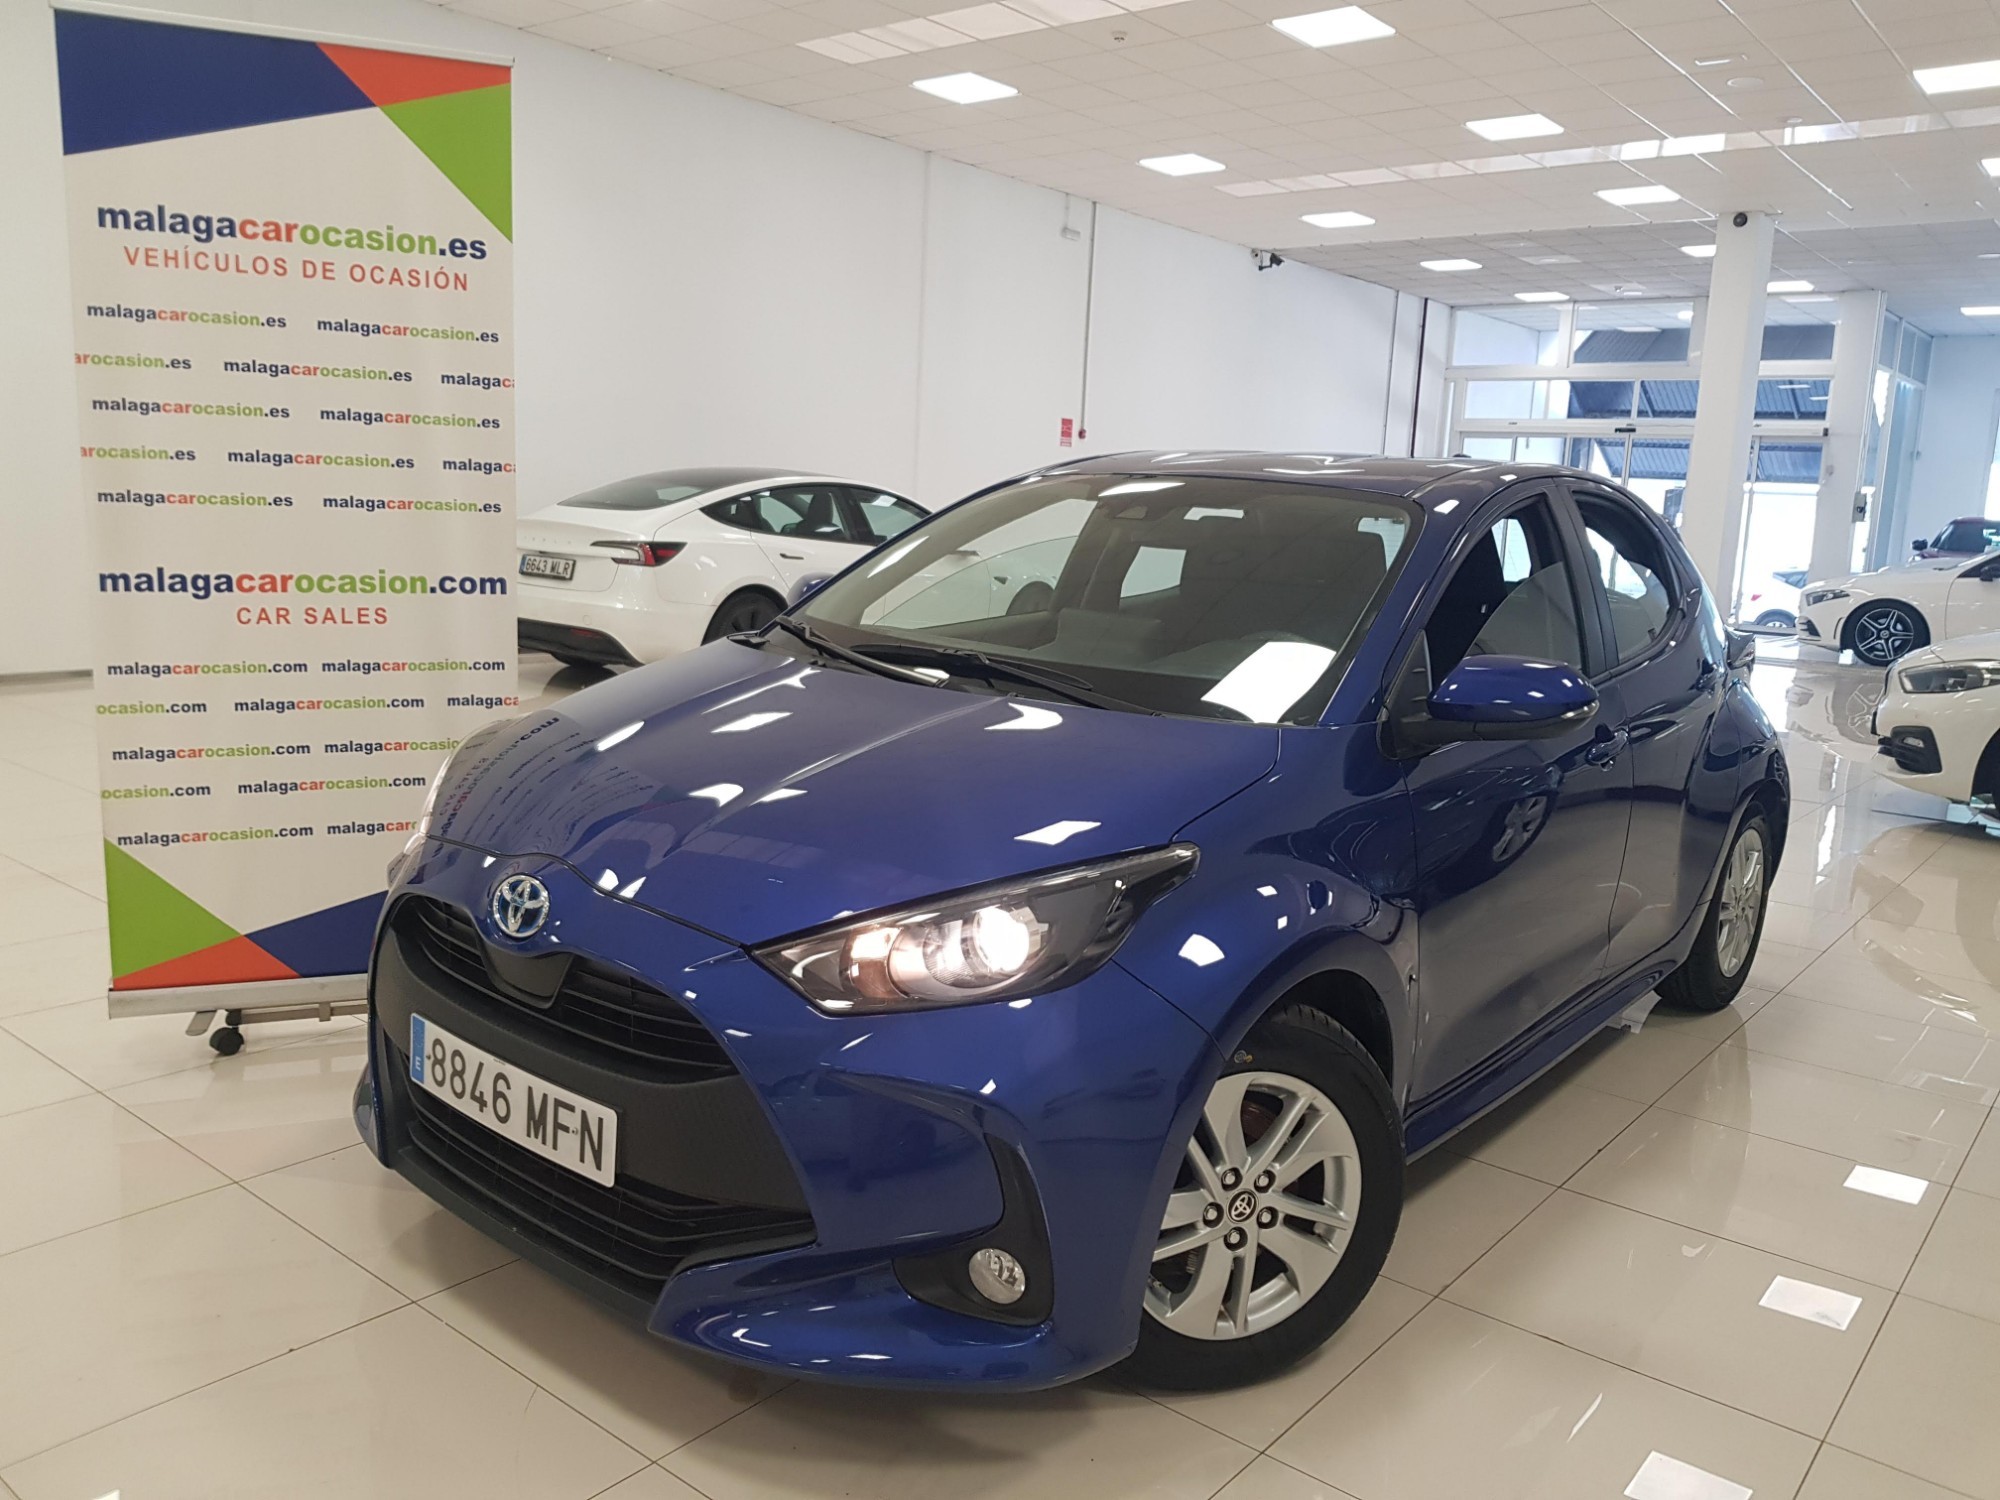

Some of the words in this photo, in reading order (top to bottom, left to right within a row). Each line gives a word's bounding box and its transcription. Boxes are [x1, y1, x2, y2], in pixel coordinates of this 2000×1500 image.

[98, 205, 487, 260] malagacarocasion.es
[124, 244, 287, 276] VEHÍCULOS
[303, 260, 335, 280] DE
[350, 264, 467, 291] OCASIÓN
[87, 303, 286, 328] malagacarocasion.es
[318, 318, 499, 342] malagacarocasion.es
[224, 360, 412, 382] malagacarocasion.es
[441, 373, 514, 390] malagac
[92, 398, 290, 418] malagacarocasion.es
[320, 408, 500, 428] malagacarocasion.es
[228, 450, 414, 468] malagacarocasion.es
[443, 458, 515, 475] malagac
[98, 489, 293, 507] malagacarocasion.es
[323, 495, 501, 513] malagacarocasion.es
[526, 557, 548, 573] 6643
[550, 560, 570, 576] MLR
[99, 567, 507, 600] malagacarocasion.com
[237, 607, 291, 624] CAR
[304, 607, 387, 624] SALES
[108, 661, 307, 678] malagacarocasion.com
[322, 659, 505, 674] malagacarocasion.com
[96, 701, 207, 714] ocasion.com
[235, 696, 424, 713] malagacarocasion.com
[113, 744, 310, 762] malagacarocasion.com
[101, 784, 211, 799] ocasion.com
[238, 777, 426, 795] malagacarocasion.com
[117, 825, 313, 847] malagacarocasion.com
[415, 1055, 422, 1071] E
[431, 1038, 511, 1124] 8846
[526, 1085, 605, 1172] MFN
